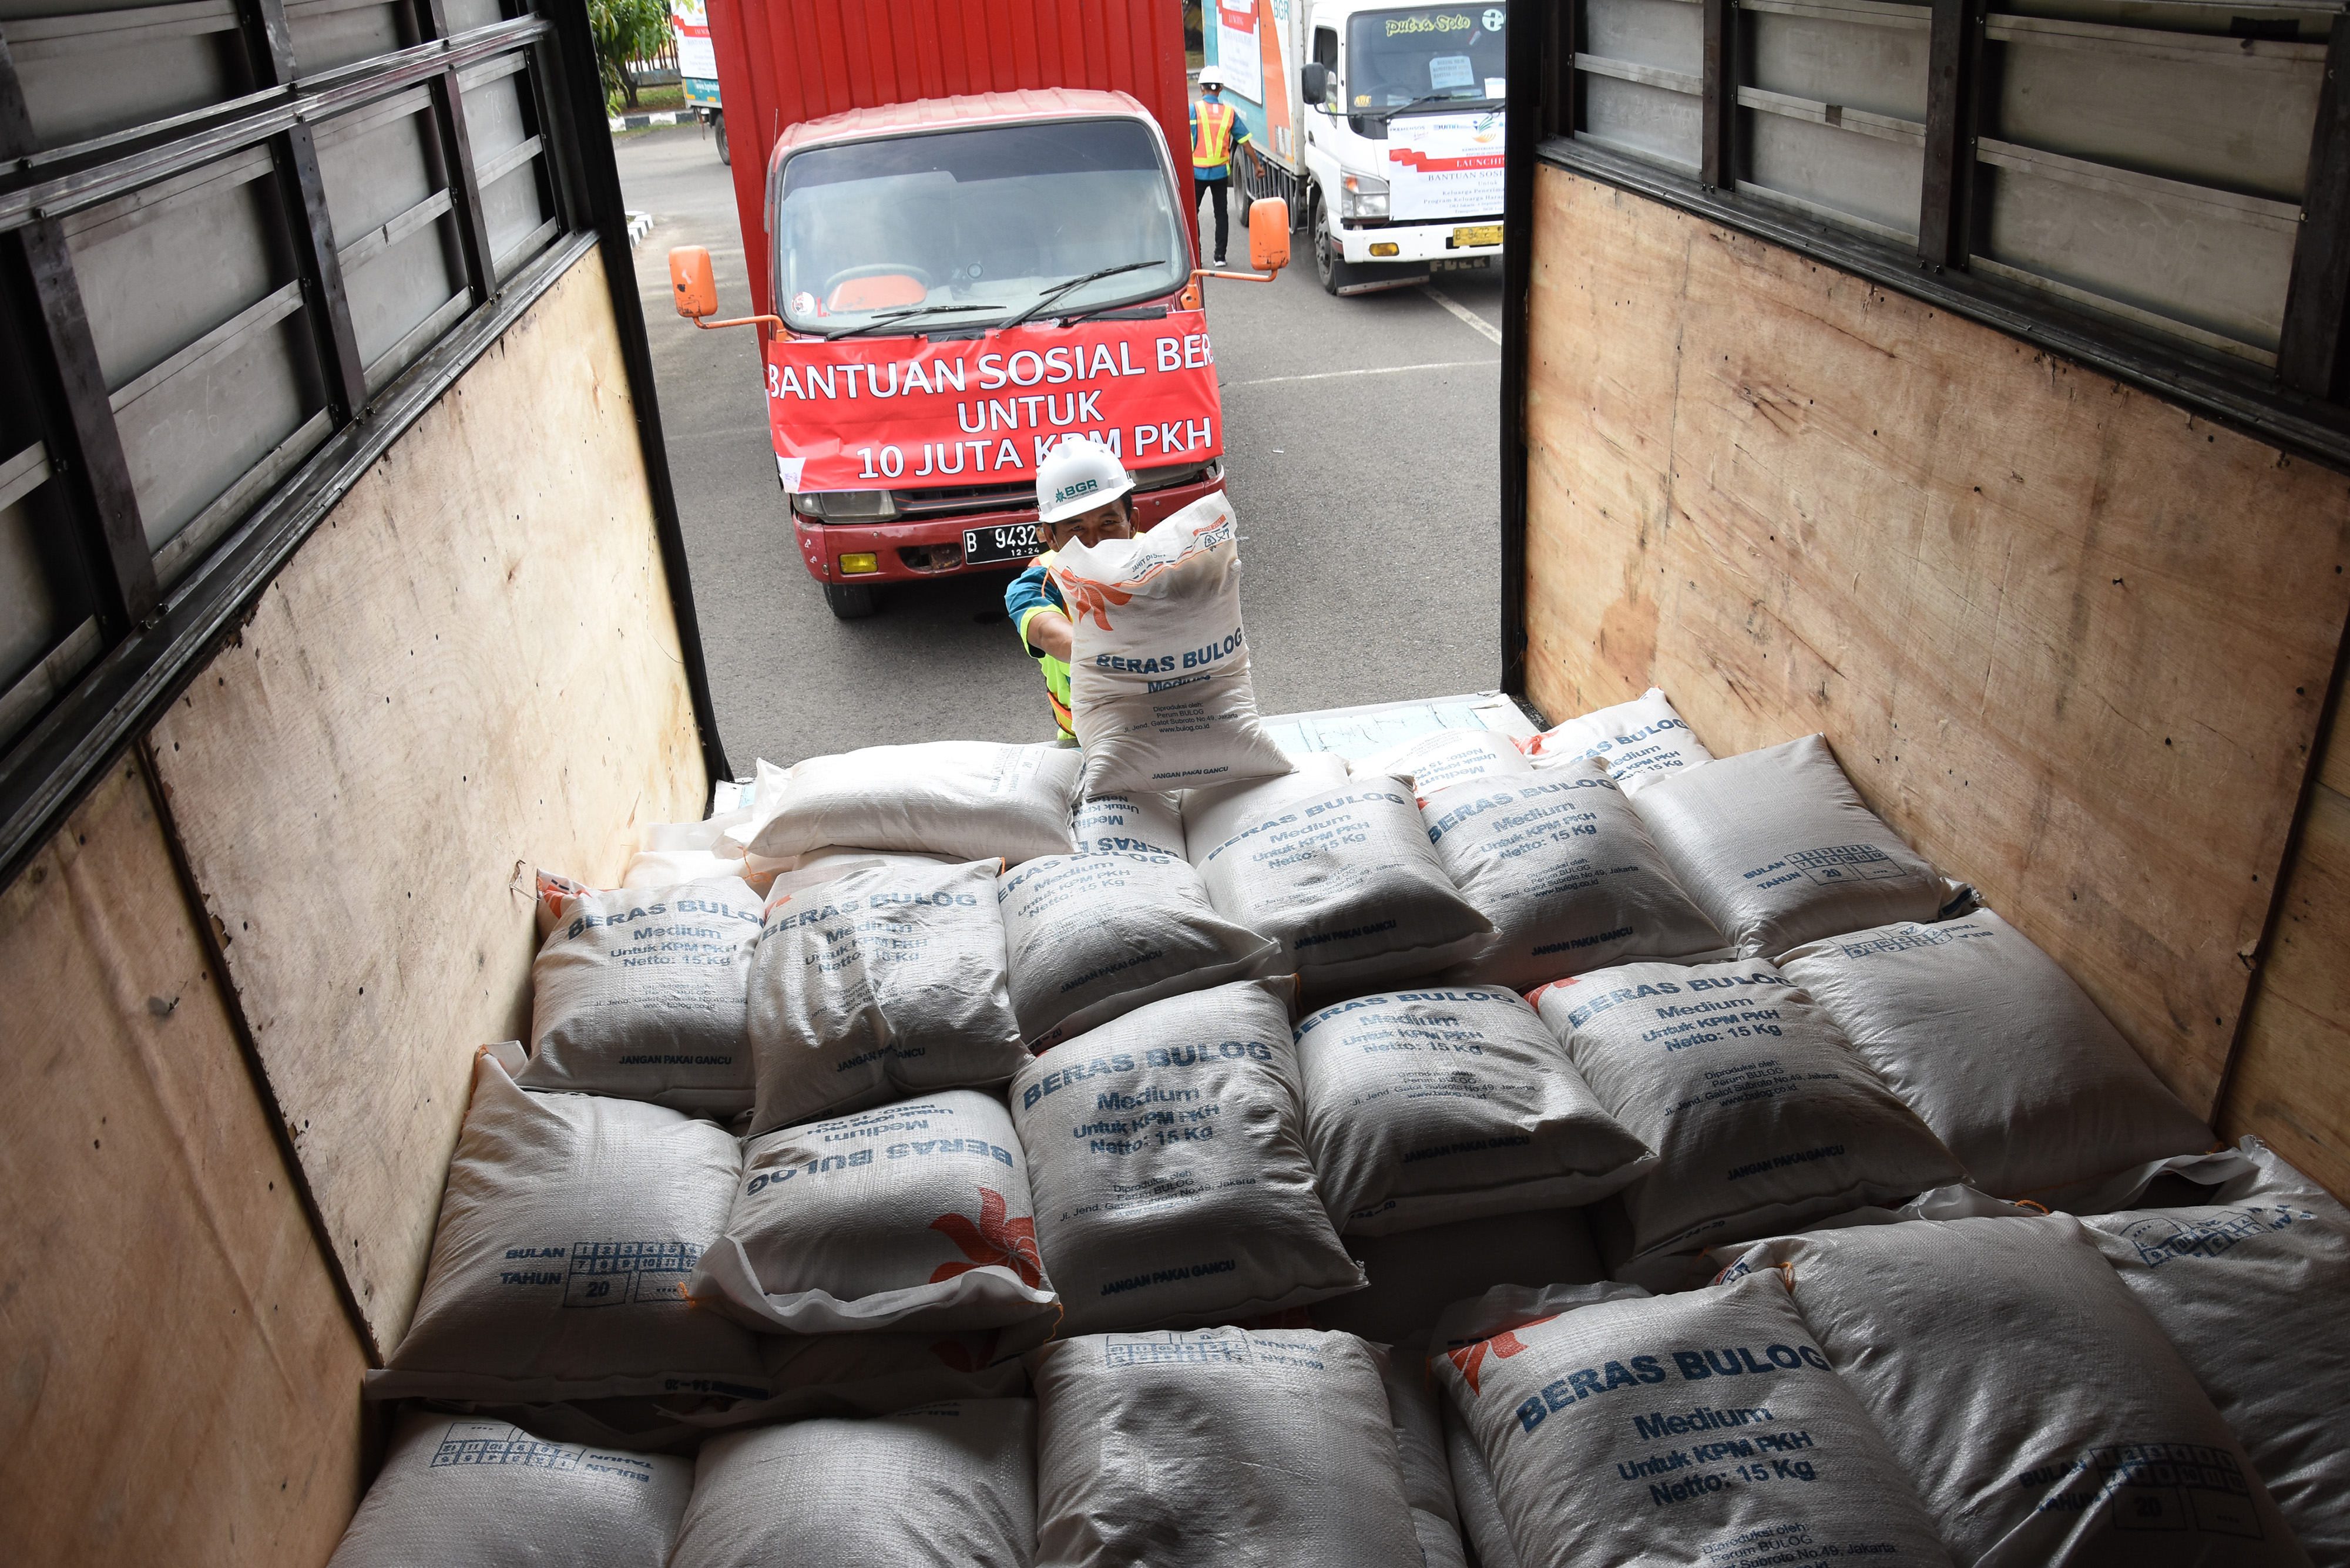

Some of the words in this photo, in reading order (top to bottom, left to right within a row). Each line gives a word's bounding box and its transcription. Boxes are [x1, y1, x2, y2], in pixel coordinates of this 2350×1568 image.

[1434, 14, 1471, 32] Solo
[1428, 172, 1476, 182] BANTUAN
[769, 357, 966, 400] BANTUAN
[978, 341, 1146, 390] SOSIAL
[957, 390, 1104, 434] UNTUK
[857, 445, 904, 479] 10
[915, 438, 1024, 477] JUTA
[1134, 417, 1212, 456] PKH
[1065, 479, 1098, 495] BGR
[966, 532, 977, 553] B
[995, 525, 1038, 549] 9432
[1132, 559, 1146, 573] JAHIT
[1096, 654, 1175, 674] BERAS
[1183, 627, 1243, 669] BULOG
[1153, 703, 1187, 712] Diproduksi
[1180, 709, 1204, 717] BULOG
[1159, 723, 1210, 734] www.bulog.co.id
[1447, 748, 1483, 761] Netto:
[1462, 753, 1497, 764] Untuk
[1626, 758, 1653, 770] KPM
[1653, 750, 1681, 762] PKH
[1663, 759, 1684, 768] Kg
[1203, 765, 1228, 775] GANCU
[1419, 765, 1485, 787] Medium
[1434, 761, 1461, 773] KPM
[1009, 773, 1020, 793] TAHUN
[1428, 793, 1513, 844] BERAS
[1523, 777, 1619, 800] BULOG
[1493, 801, 1576, 833] Medium
[1208, 813, 1297, 861] BERAS
[1304, 793, 1405, 819] BULOG
[1270, 814, 1352, 844] Medium
[1743, 861, 1785, 880] BULAN
[1756, 871, 1802, 890] TAHUN
[1821, 868, 1842, 878] 20
[762, 900, 859, 941] BERAS
[870, 891, 977, 908] BULOG
[634, 924, 723, 941] Medium
[826, 921, 912, 945] Medium
[1532, 941, 1570, 956] JANGAN
[1571, 936, 1599, 949] PAKAI
[1600, 926, 1633, 942] GANCU
[1292, 996, 1389, 1046] BERAS
[1400, 991, 1516, 1004] BULOG
[1359, 1013, 1458, 1027] Medium
[1656, 998, 1754, 1020] Medium
[1642, 1021, 1696, 1043] Untuk
[1698, 1012, 1738, 1030] KPM
[1740, 1009, 1781, 1023] PKH
[1664, 1030, 1723, 1053] Netto:
[1727, 1026, 1751, 1039] 15
[1753, 1022, 1783, 1037] Kg
[619, 1056, 664, 1065] JANGAN
[664, 1055, 693, 1065] PAKAI
[694, 1056, 732, 1066] GANCU
[1024, 1052, 1136, 1111] BERAS
[1146, 1040, 1273, 1067] BULOG
[1711, 1074, 1746, 1088] Perum
[1747, 1067, 1784, 1079] BULOG
[1097, 1084, 1200, 1113] Medium
[1718, 1084, 1797, 1107] www.bulog.co.id
[824, 1119, 929, 1142] Medium
[885, 1139, 1014, 1169] BERAS
[1402, 1145, 1451, 1164] JANGAN
[1452, 1139, 1488, 1154] PAKAI
[1489, 1134, 1531, 1149] GANCU
[747, 1147, 874, 1197] BULOG
[1727, 1160, 1772, 1181] JANGAN
[1773, 1151, 1807, 1169] PAKAI
[1807, 1144, 1845, 1161] GANCU
[505, 1247, 565, 1259] BULAN
[582, 1245, 588, 1254] 1
[602, 1246, 610, 1255] 2
[624, 1244, 633, 1254] 3
[645, 1244, 654, 1254] 4
[667, 1245, 676, 1254] 5
[578, 1260, 587, 1269] 7
[599, 1260, 608, 1269] 8
[622, 1260, 630, 1268] 9
[643, 1258, 655, 1267] 10
[664, 1259, 676, 1267] 11
[500, 1272, 562, 1285] TAHUN
[588, 1281, 611, 1297] 20
[1100, 1275, 1151, 1296] JANGAN
[1152, 1269, 1191, 1285] PAKAI
[1191, 1259, 1236, 1280] GANCU
[1514, 1354, 1668, 1435] BERAS
[1669, 1342, 1833, 1382] BULOG
[1632, 1405, 1774, 1442] Medium
[589, 1453, 654, 1469] TAHUN
[1616, 1446, 1691, 1483] Untuk
[1691, 1436, 1755, 1465] KPM
[1758, 1430, 1815, 1454] PKH
[1649, 1469, 1733, 1507] Netto:
[1735, 1459, 1770, 1484] 15
[1775, 1456, 1818, 1483] Kg
